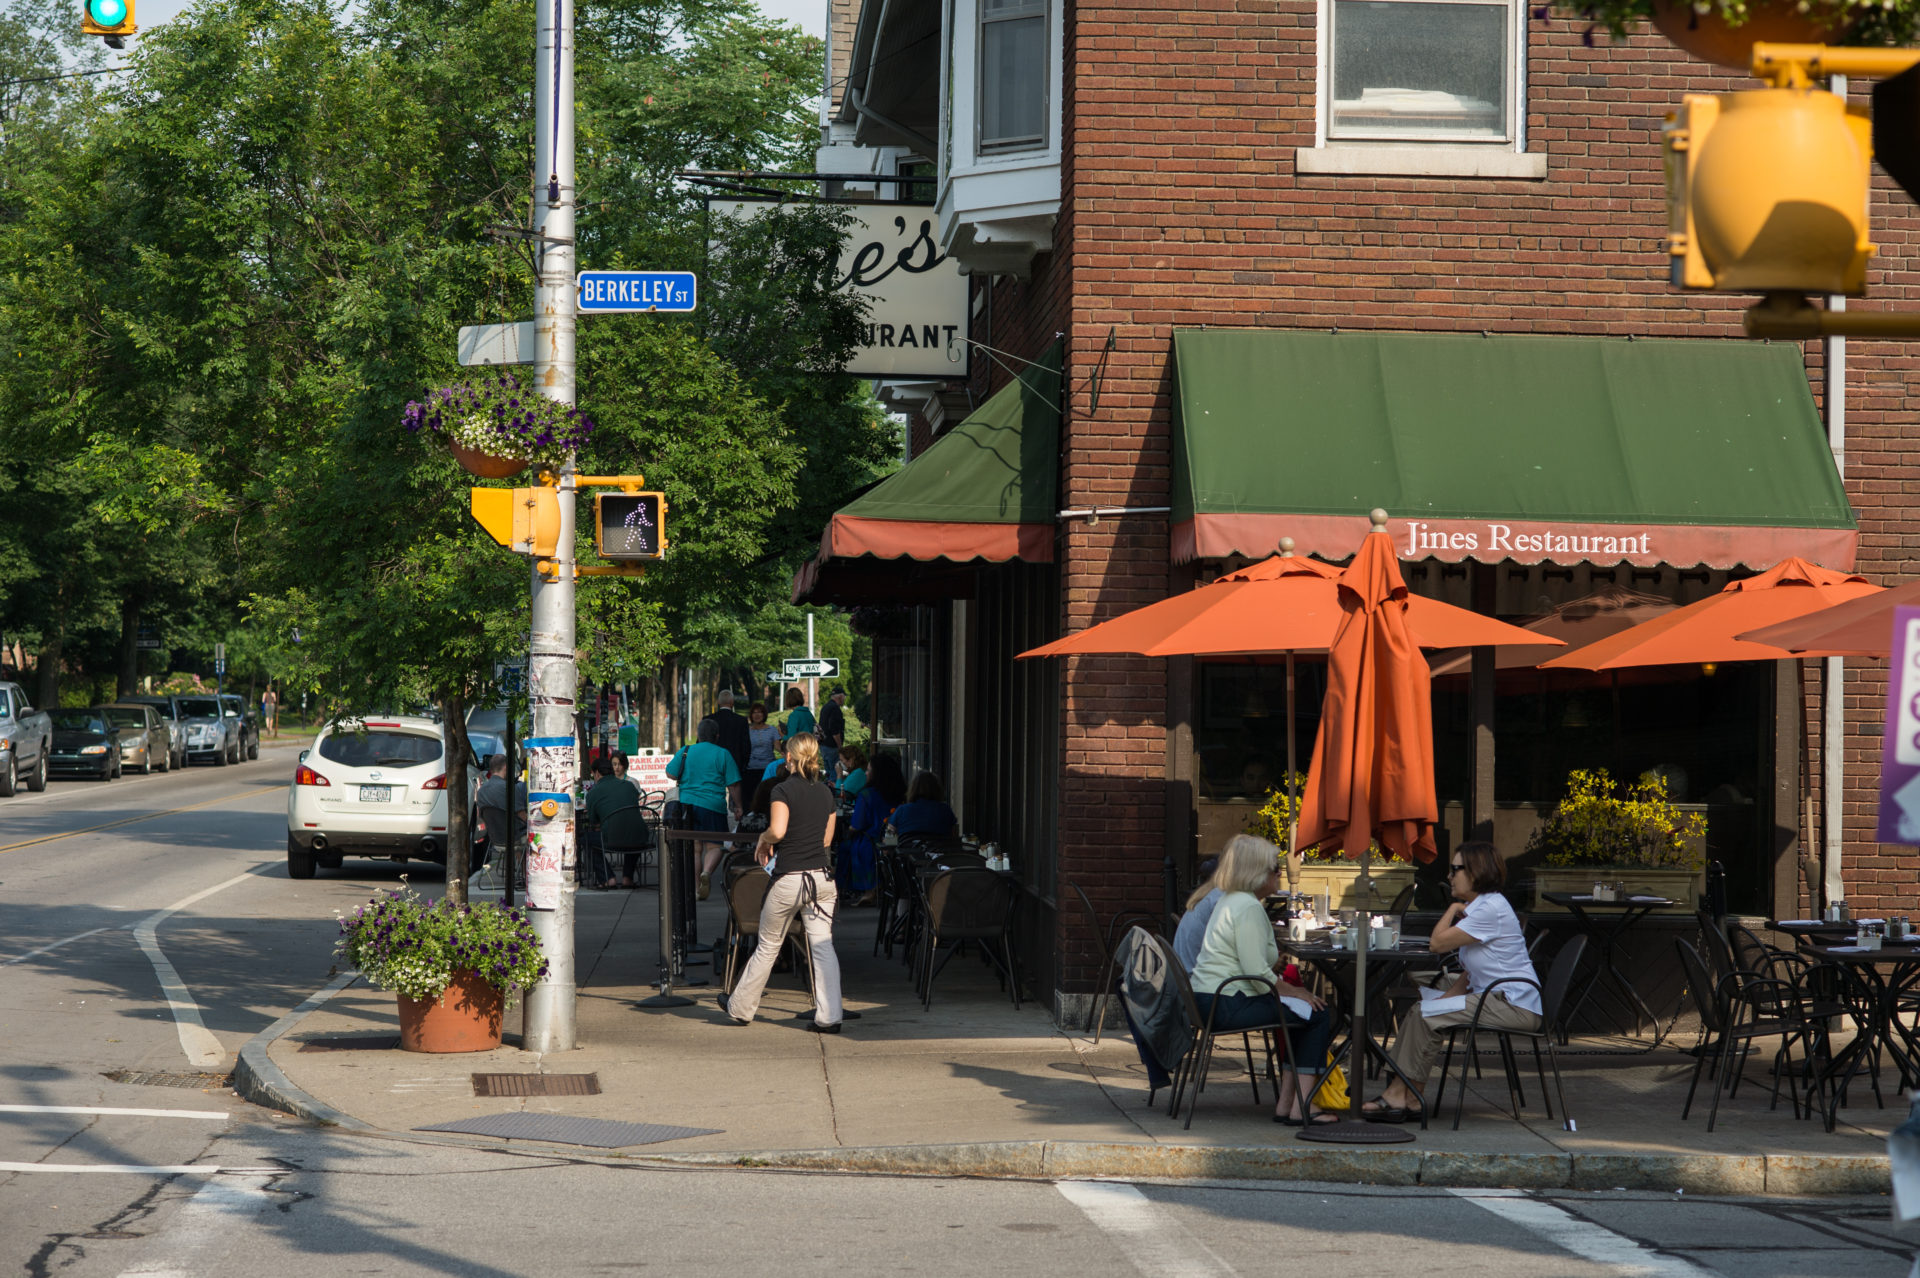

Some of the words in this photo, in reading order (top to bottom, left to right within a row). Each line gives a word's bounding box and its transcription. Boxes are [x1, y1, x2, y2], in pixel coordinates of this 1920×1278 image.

[584, 280, 675, 303] BERKELEY
[674, 290, 689, 303] ST
[858, 323, 959, 349] URANT
[1404, 521, 1479, 556] Jines
[1487, 524, 1651, 555] Restaurant
